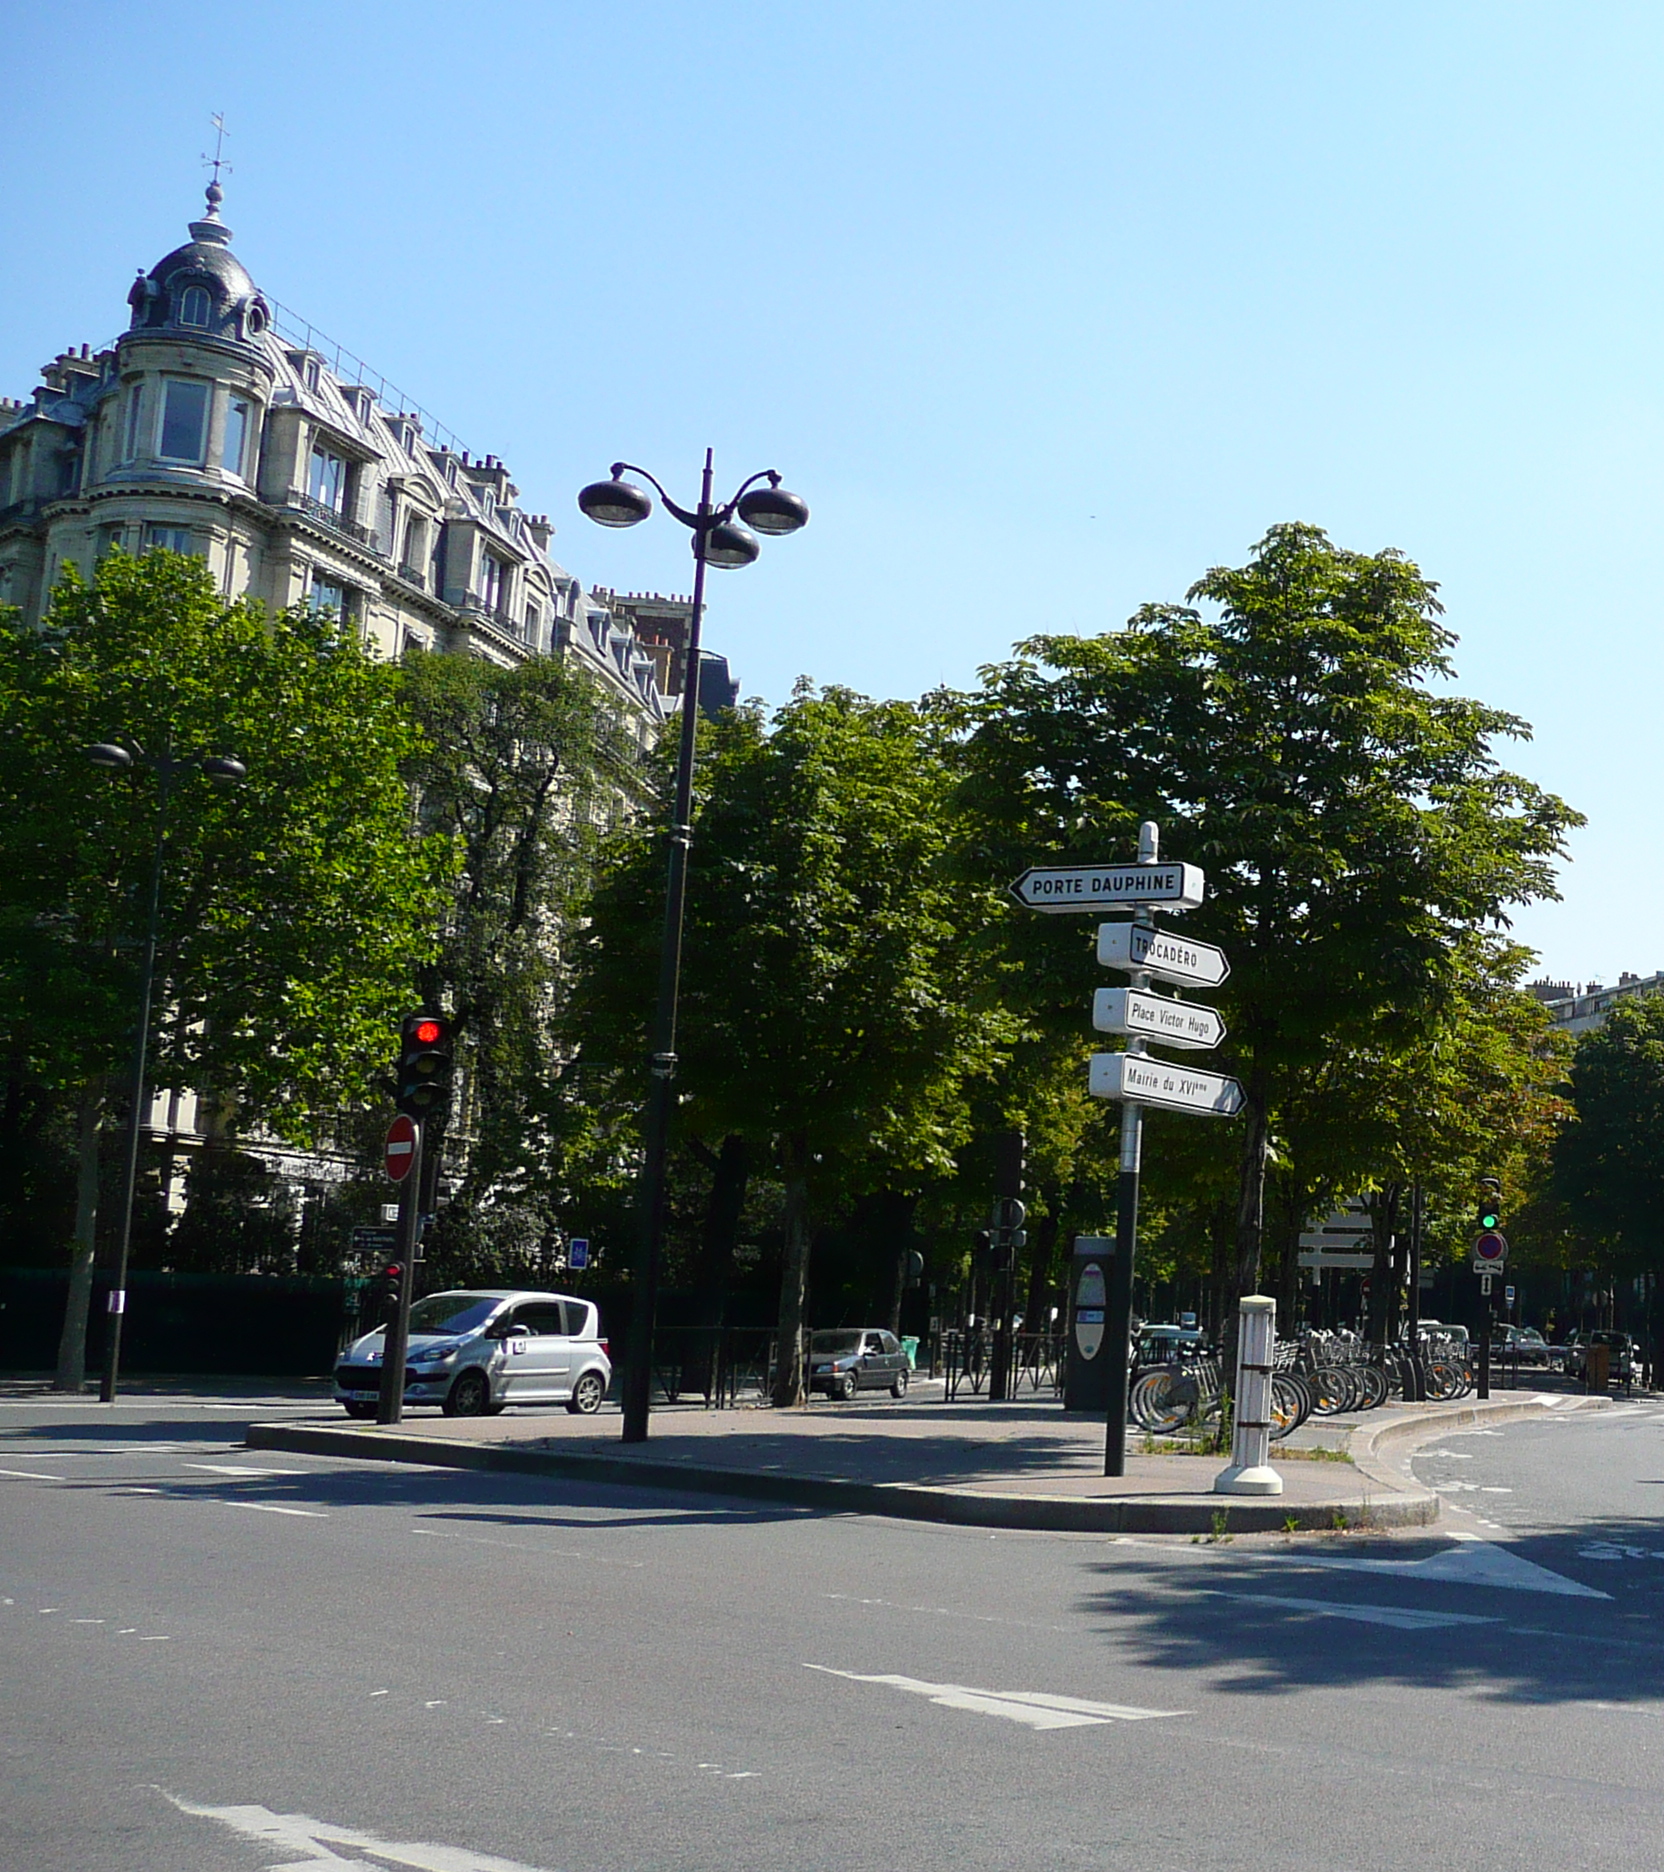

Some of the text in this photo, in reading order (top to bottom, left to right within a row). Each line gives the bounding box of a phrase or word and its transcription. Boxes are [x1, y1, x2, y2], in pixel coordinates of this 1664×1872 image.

[1033, 874, 1175, 894] PORTE DAUPHINE
[1136, 937, 1197, 967] TROCADÉRO
[1131, 1003, 1209, 1037] Place Victor Hugo
[1128, 1068, 1159, 1088] Mairie
[1163, 1076, 1174, 1091] du
